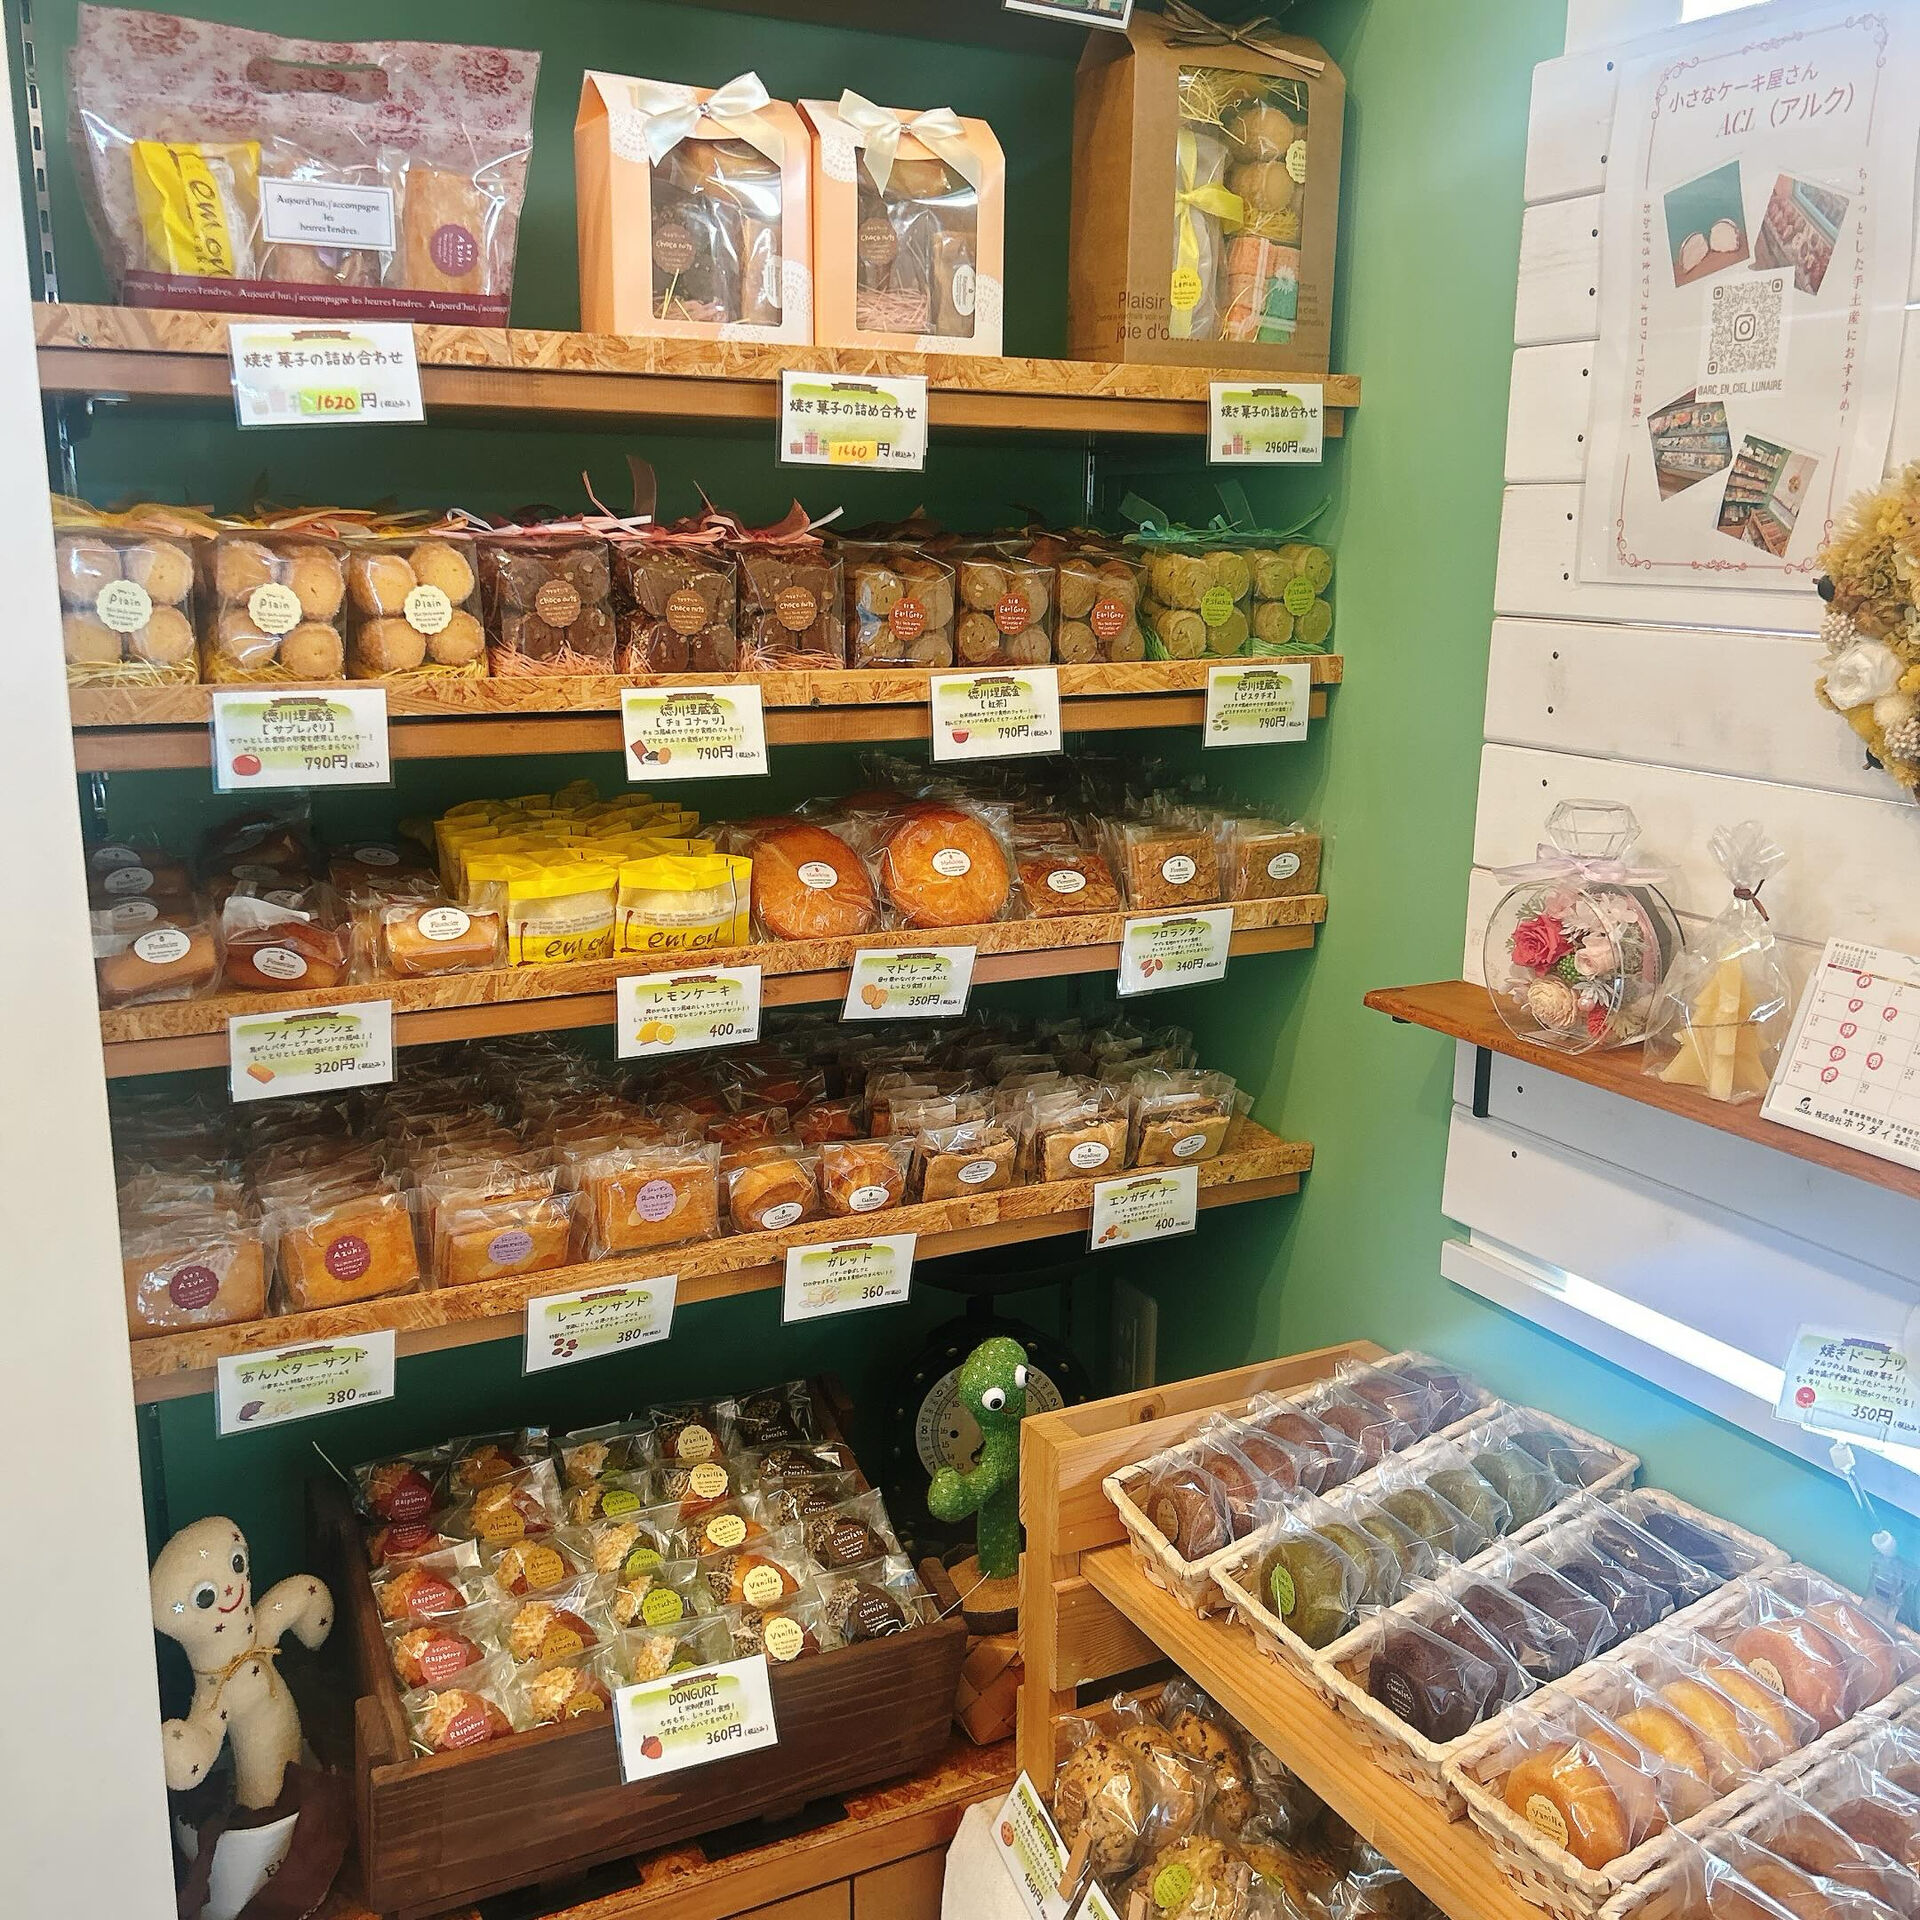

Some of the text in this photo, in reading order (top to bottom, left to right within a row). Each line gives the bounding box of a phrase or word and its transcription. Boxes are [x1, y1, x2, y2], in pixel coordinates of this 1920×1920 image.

[1669, 62, 1819, 113] 小さなケーキ屋さん
[1118, 291, 1165, 310] Plaisir
[1116, 321, 1142, 343] joie
[243, 350, 404, 369] 焼き菓子の詰め合わせ
[789, 398, 917, 420] 焼き菓子の詰め合わせ
[1221, 404, 1318, 419] 焼き菓子の詰め合わせ
[1265, 440, 1298, 454] 2960円
[109, 593, 141, 607] Plain
[259, 598, 290, 609] Plain
[414, 599, 441, 609] Plain
[968, 685, 1021, 700] 徳川埋蔵金
[1237, 679, 1284, 692] 徳川埋蔵金
[262, 707, 337, 723] 徳川埋蔵金
[660, 702, 723, 717] 徳川埋蔵金
[1259, 715, 1286, 729] 790円
[997, 724, 1029, 739] 790円
[697, 745, 733, 760] 790円
[304, 754, 349, 771] 790円
[1151, 926, 1206, 940] フロランタン
[886, 963, 943, 974] マドレーヌ
[1175, 958, 1204, 972] 340円
[653, 984, 731, 1004] レモンケーキ
[908, 994, 940, 1007] 350円
[264, 1022, 355, 1042] フィナンシェ
[708, 1022, 735, 1038] 400
[314, 1057, 356, 1075] 320円
[1109, 1187, 1178, 1207] エンガディナー
[1154, 1217, 1175, 1231] 400
[826, 1252, 872, 1268] ガレット
[861, 1284, 884, 1300] 360
[557, 1295, 649, 1323] レーズンサンド
[616, 1328, 642, 1344] 380
[1819, 1343, 1908, 1372] 焼きドーナツ
[240, 1350, 369, 1385] あんバターサンド
[326, 1387, 357, 1405] 380
[1851, 1404, 1893, 1426] 350円
[921, 1425, 929, 1435] 8
[682, 1436, 708, 1446] Vanilla
[695, 1470, 723, 1479] Vanilla
[711, 1520, 739, 1534] Vanilla
[748, 1577, 778, 1590] Vanilla
[412, 1591, 447, 1606] Raspberry
[859, 1602, 889, 1618] Chocolate
[770, 1629, 799, 1641] Vanilla
[425, 1651, 462, 1663] Raspberry
[668, 1683, 719, 1706] DONGURI
[450, 1720, 485, 1739] Raspberry
[706, 1723, 742, 1745] 360円
[1024, 1871, 1044, 1907] 450円
